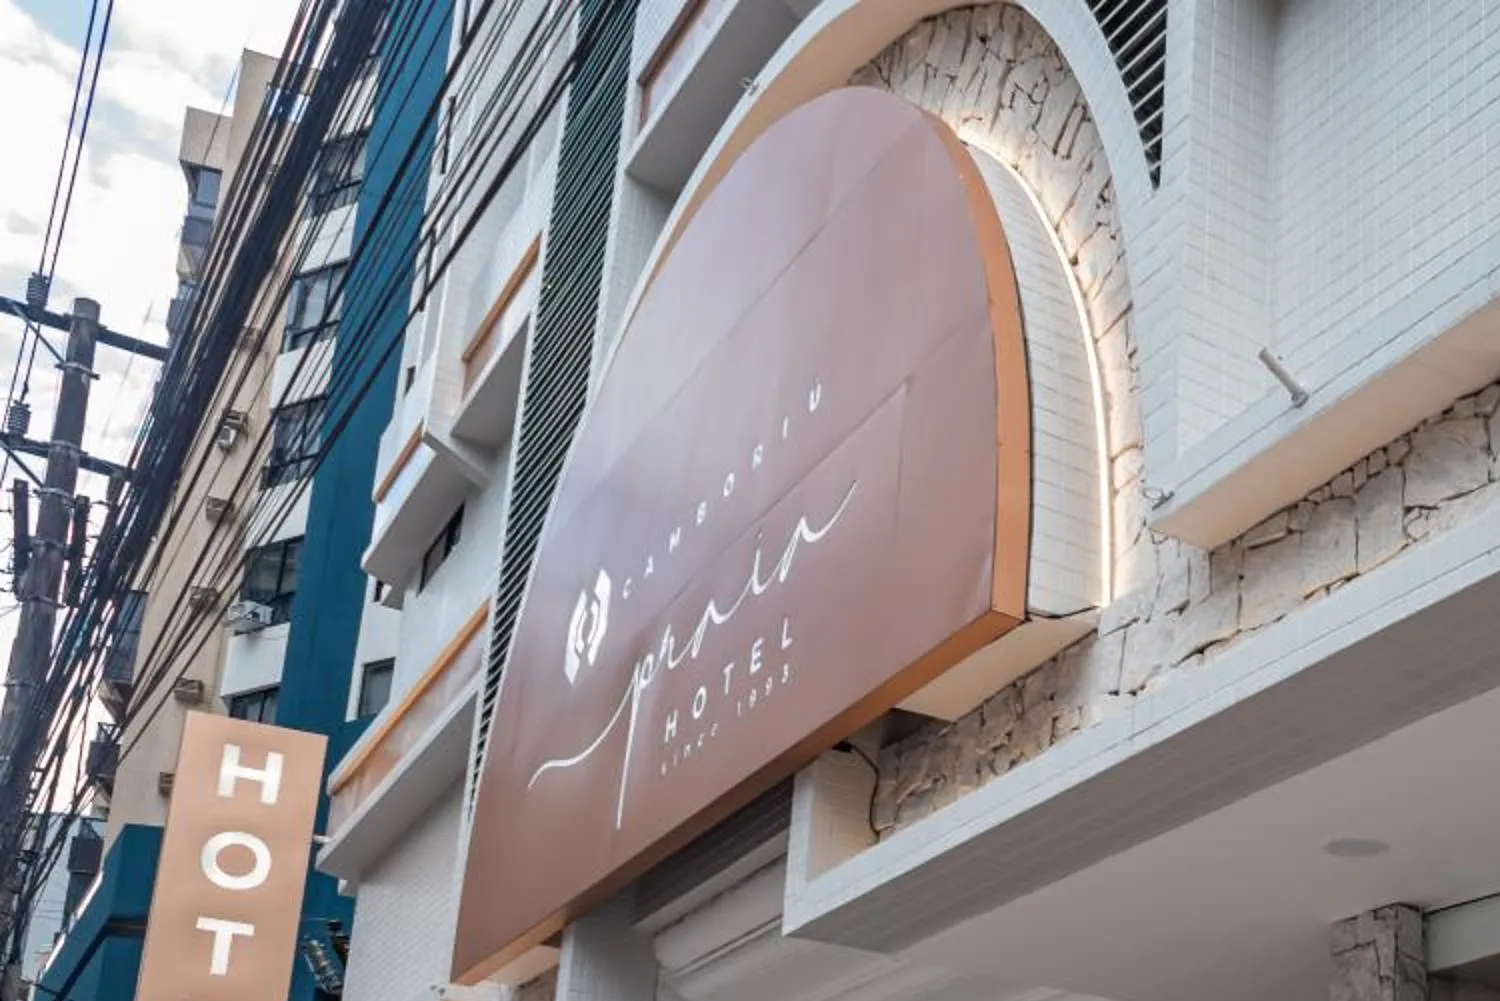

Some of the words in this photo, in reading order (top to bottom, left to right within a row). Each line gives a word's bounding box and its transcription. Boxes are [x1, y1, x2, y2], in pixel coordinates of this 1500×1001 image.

[622, 383, 822, 600] CAMBORIU
[528, 480, 858, 830] praia
[663, 616, 794, 744] HOTEL
